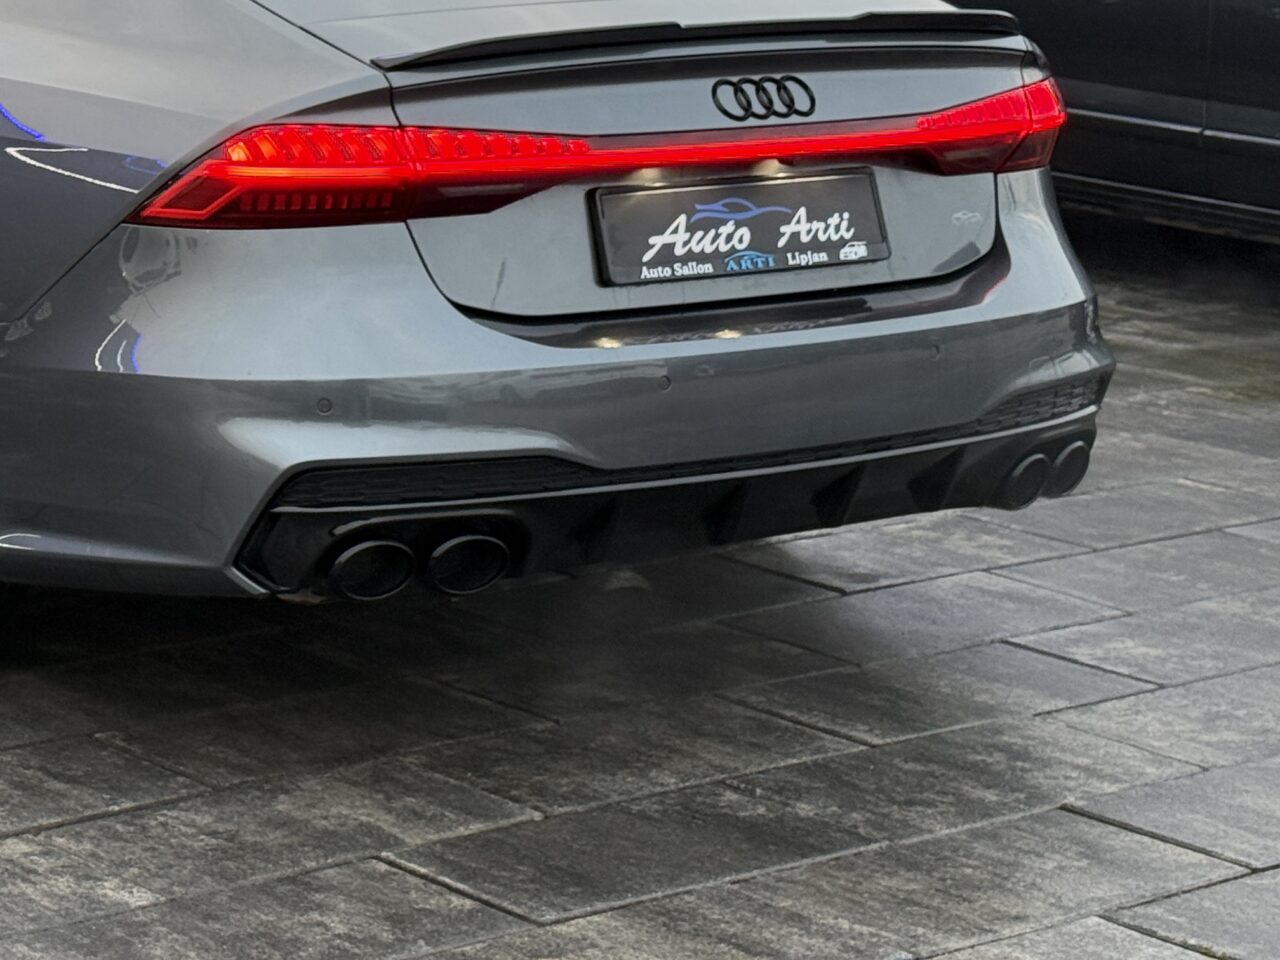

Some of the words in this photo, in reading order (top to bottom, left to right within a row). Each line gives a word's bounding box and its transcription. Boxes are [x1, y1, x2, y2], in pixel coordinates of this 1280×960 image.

[641, 212, 752, 263] Auto
[776, 205, 856, 248] Arti
[640, 265, 672, 280] Auto
[725, 254, 776, 272] ARTI
[786, 249, 829, 267] Lipjan
